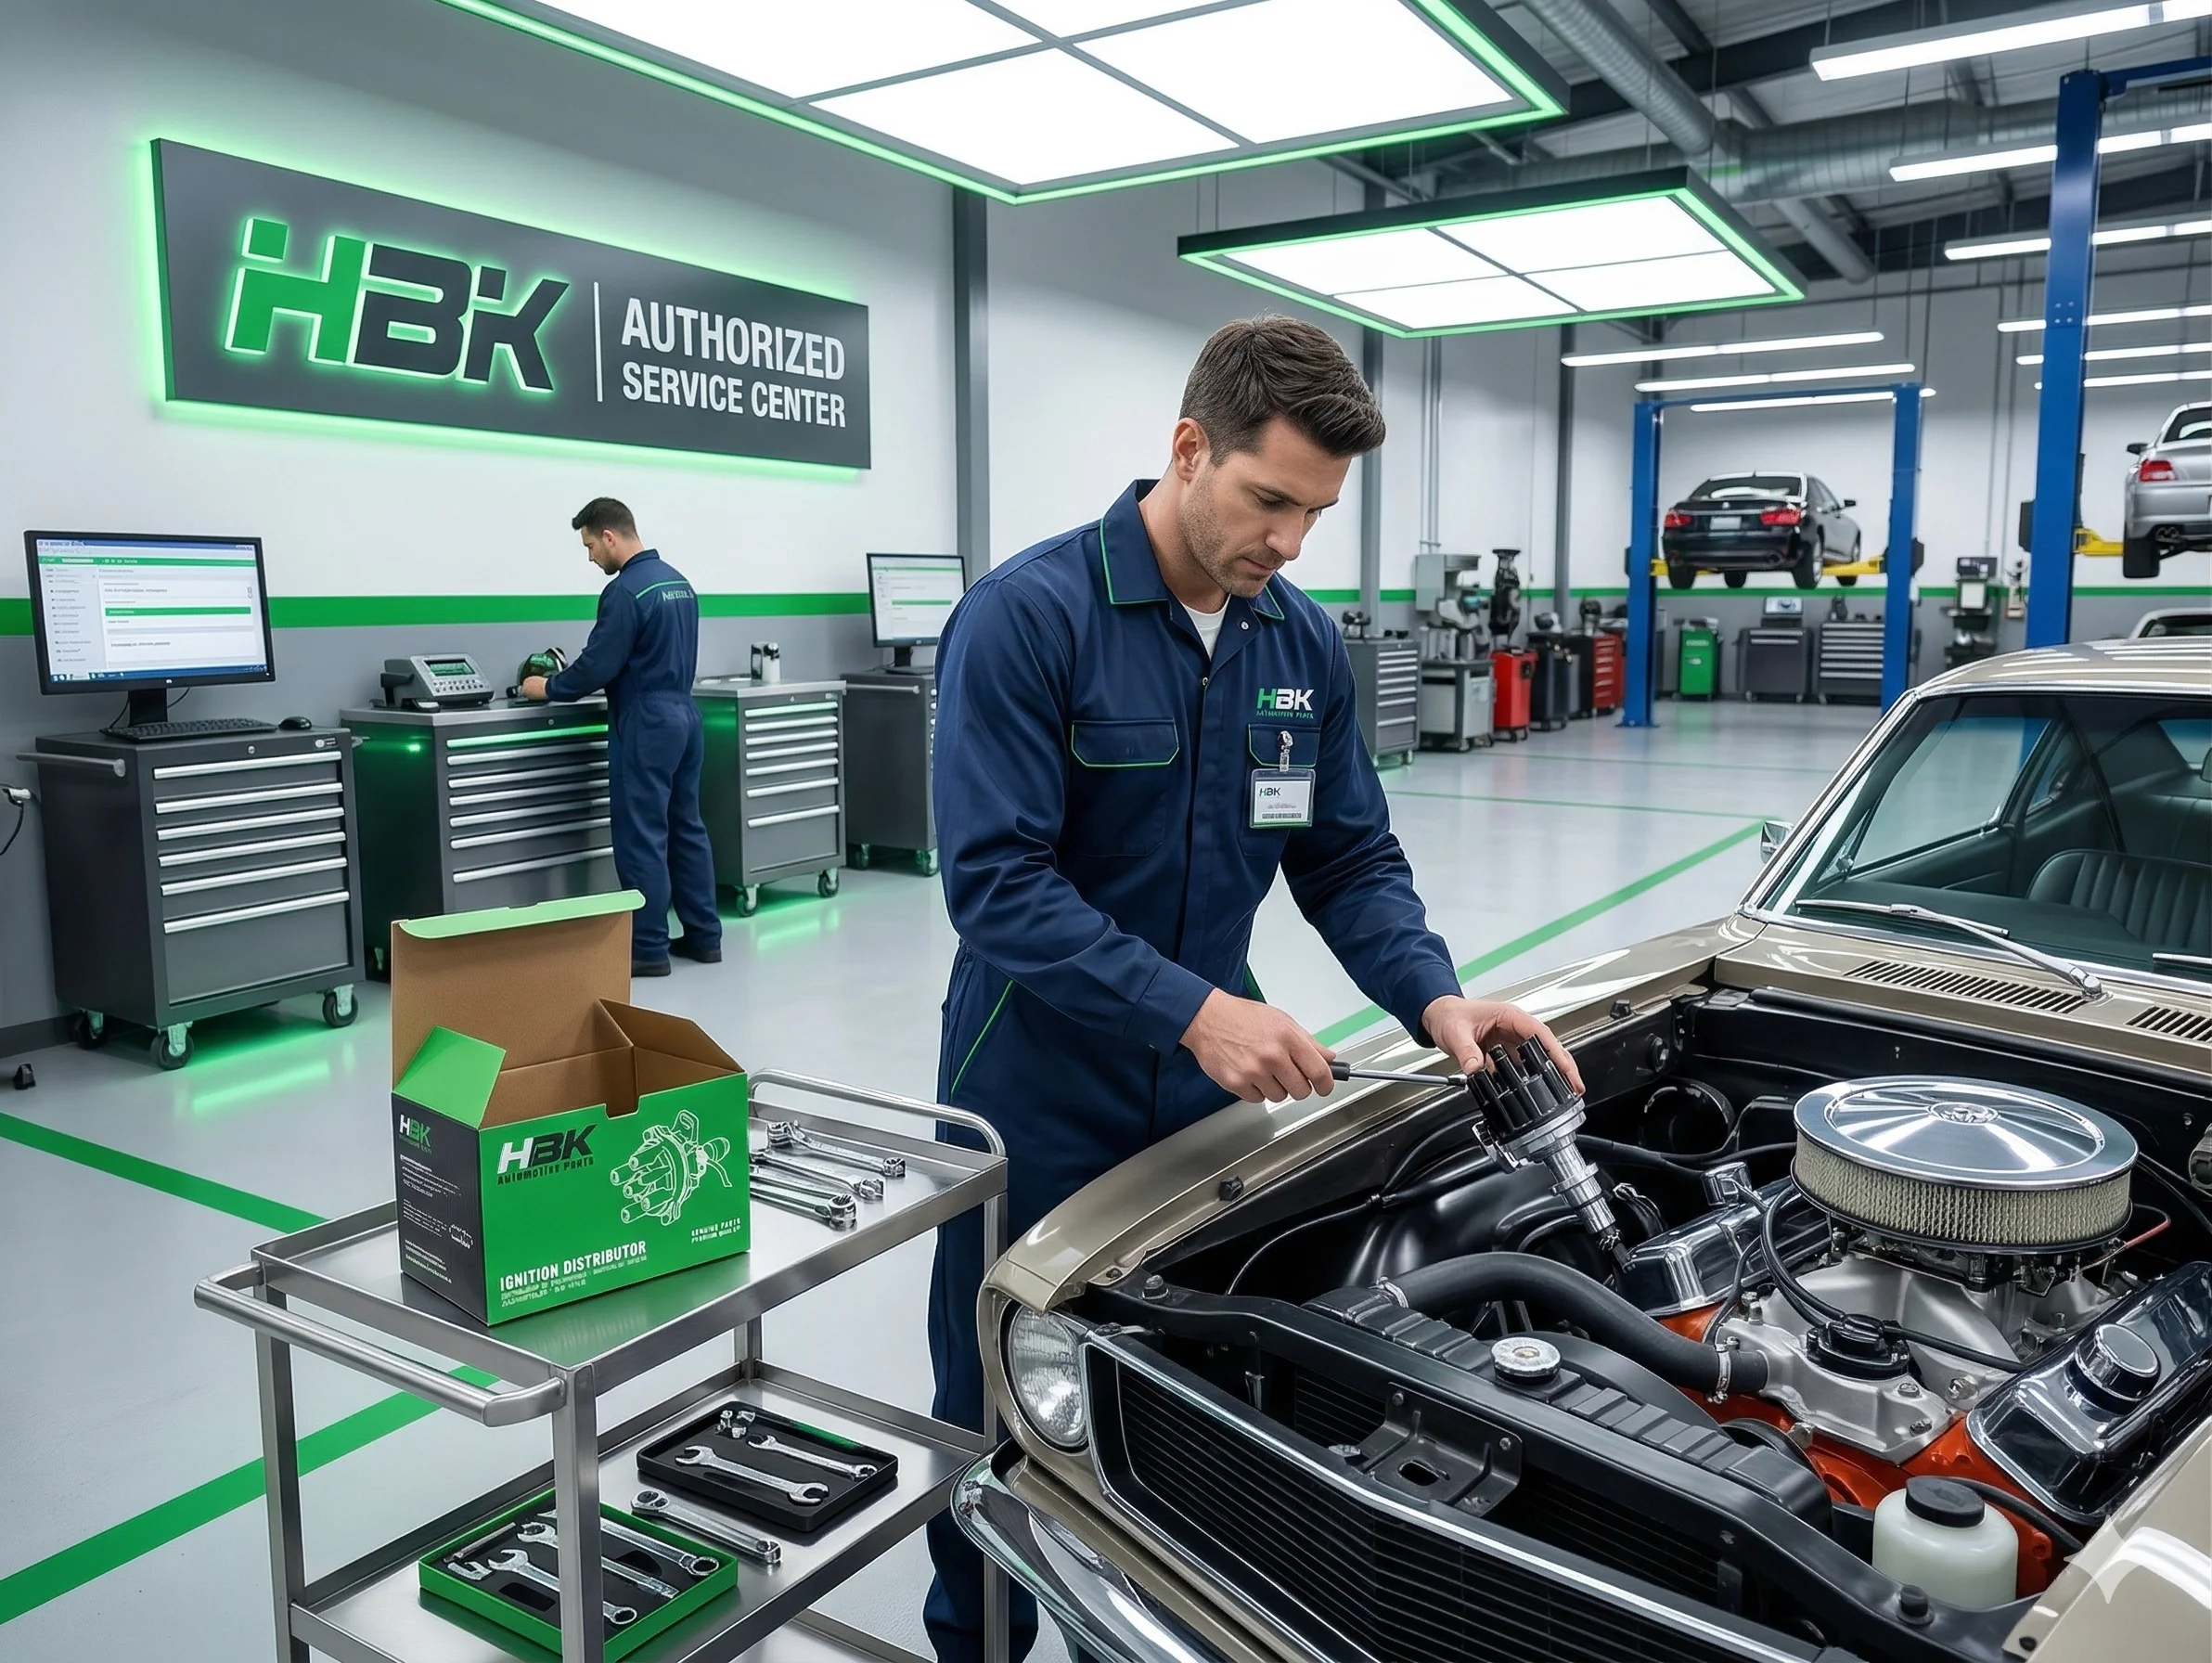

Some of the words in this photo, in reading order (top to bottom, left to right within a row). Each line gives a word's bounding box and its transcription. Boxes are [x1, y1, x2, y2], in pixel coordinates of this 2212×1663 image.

[225, 218, 570, 393] HBK
[621, 297, 845, 380] AUTHORIZED
[622, 361, 743, 414] SERVICE
[751, 381, 846, 428] CENTER
[1256, 688, 1314, 711] HBK
[1259, 787, 1281, 797] HBK
[399, 1114, 431, 1148] HBK
[497, 1123, 598, 1175] HBK
[500, 1263, 559, 1292] IGNITION
[563, 1240, 647, 1275] DISTRIBUTOR
